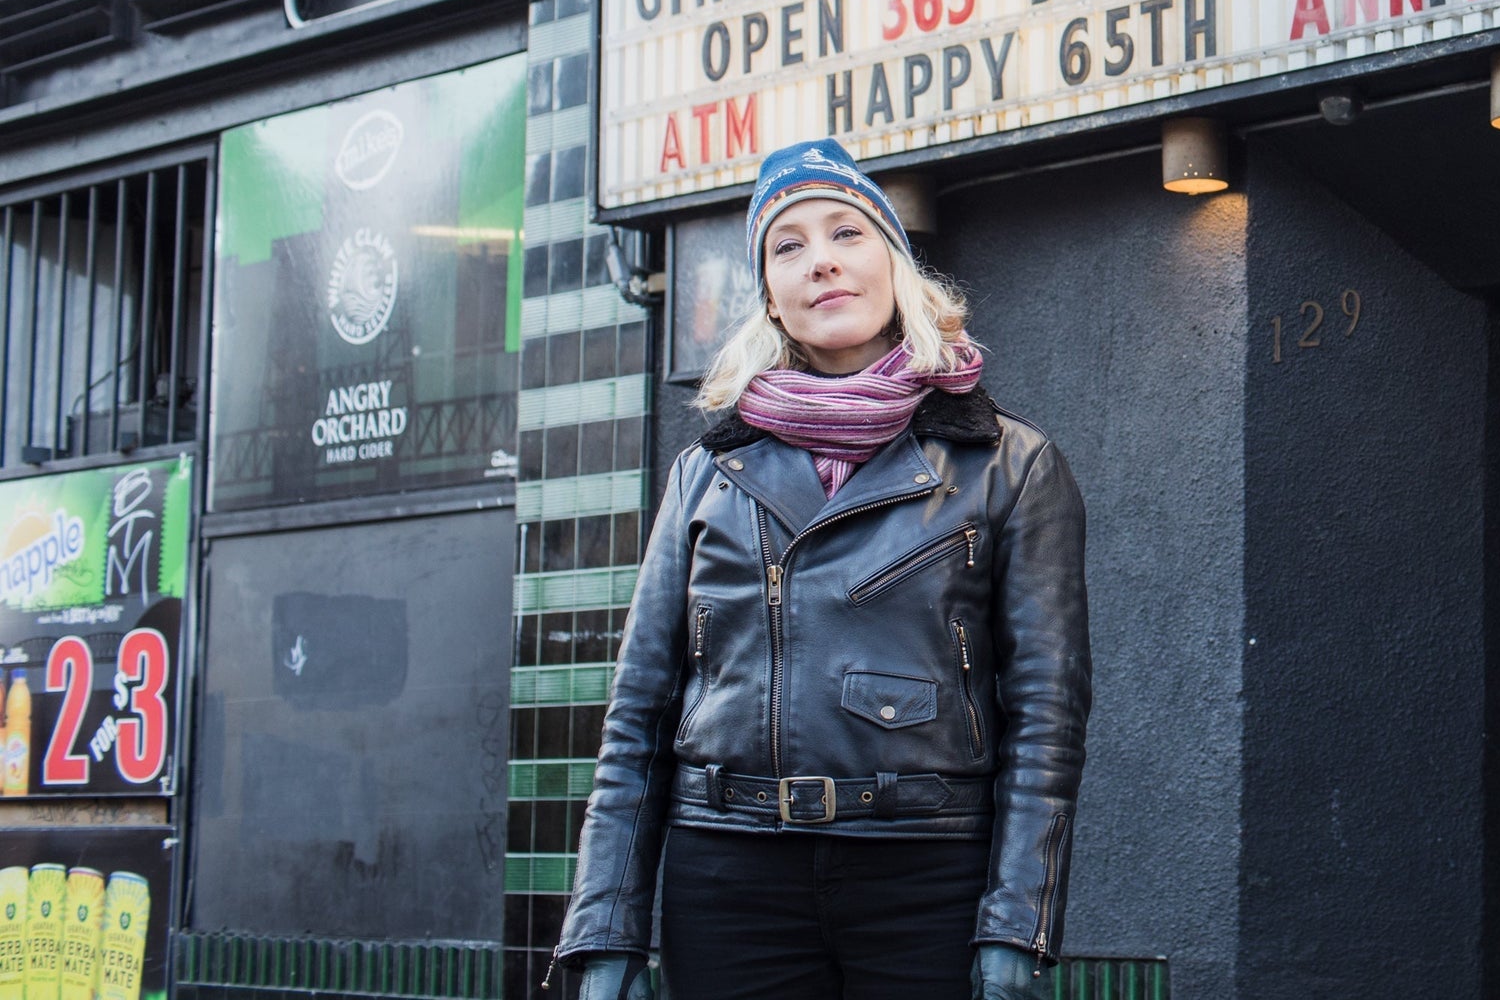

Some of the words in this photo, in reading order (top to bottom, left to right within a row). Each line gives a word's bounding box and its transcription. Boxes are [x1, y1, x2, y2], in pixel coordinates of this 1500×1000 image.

[659, 92, 759, 174] ATM
[825, 30, 1019, 136] HAPPY
[328, 235, 354, 309] WHITE
[355, 227, 394, 260] CLAW
[1270, 289, 1361, 365] 129
[325, 379, 393, 416] ANGRY
[311, 407, 408, 446] ORCHARD
[326, 445, 357, 464] HARD
[358, 440, 393, 460] CIDER
[43, 635, 94, 785] 2
[90, 715, 120, 762] FOR
[101, 949, 140, 974] YERBA
[103, 966, 135, 989] MATE
